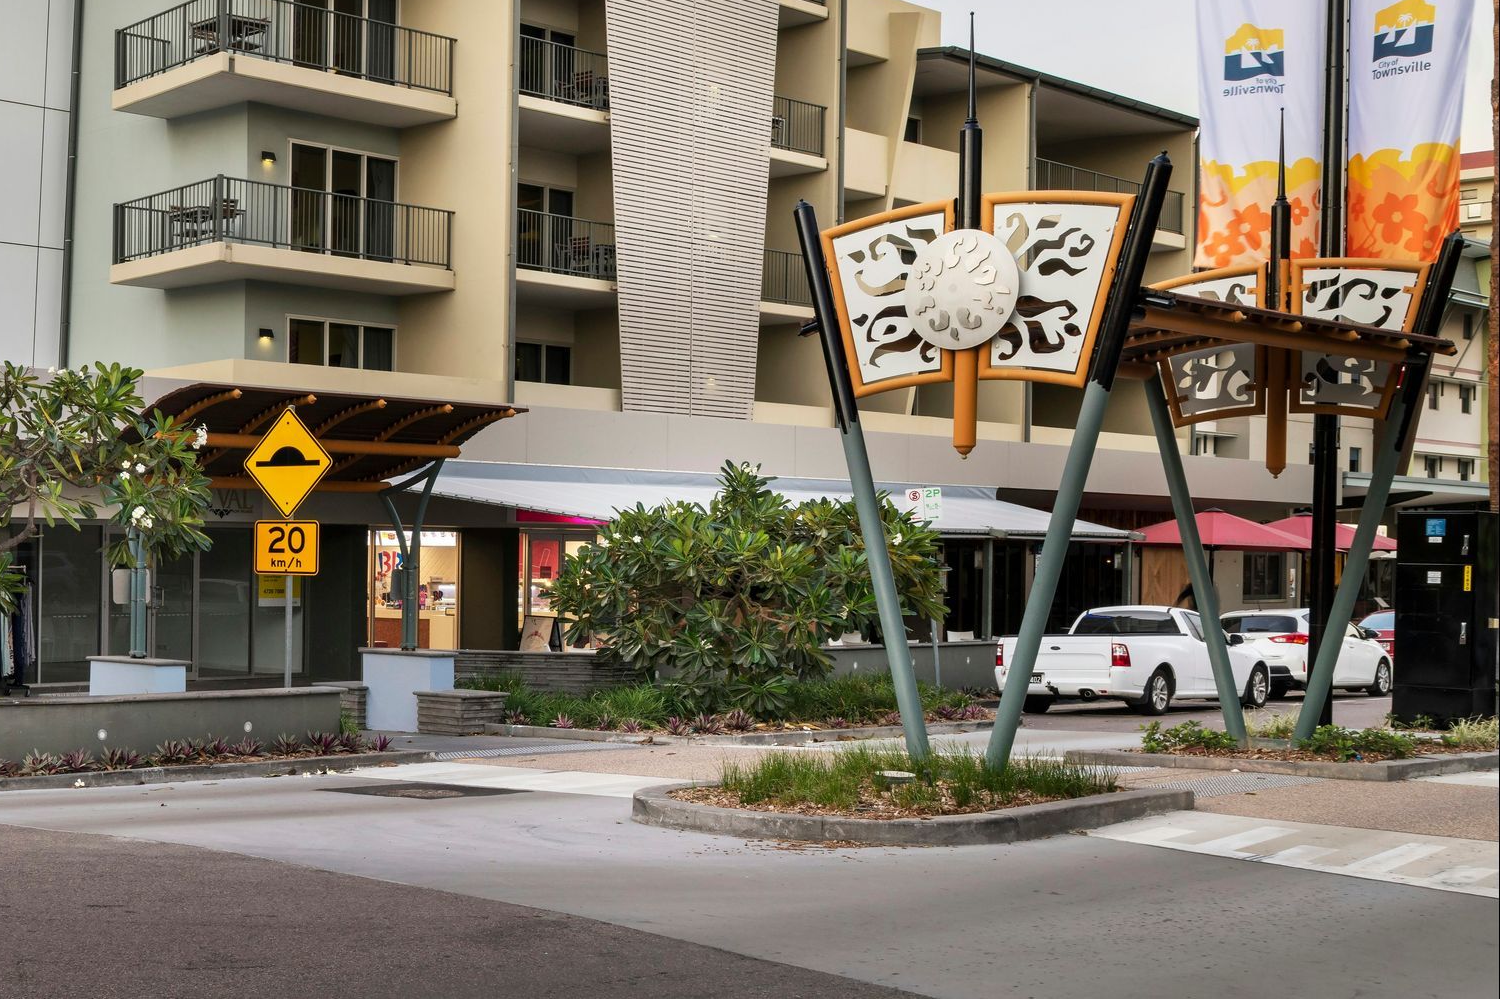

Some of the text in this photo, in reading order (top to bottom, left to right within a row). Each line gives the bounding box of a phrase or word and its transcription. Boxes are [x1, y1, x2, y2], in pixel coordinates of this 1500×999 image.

[1372, 60, 1431, 80] Townsville
[925, 489, 940, 498] 2P
[268, 526, 305, 554] 20
[270, 557, 302, 569] km/h
